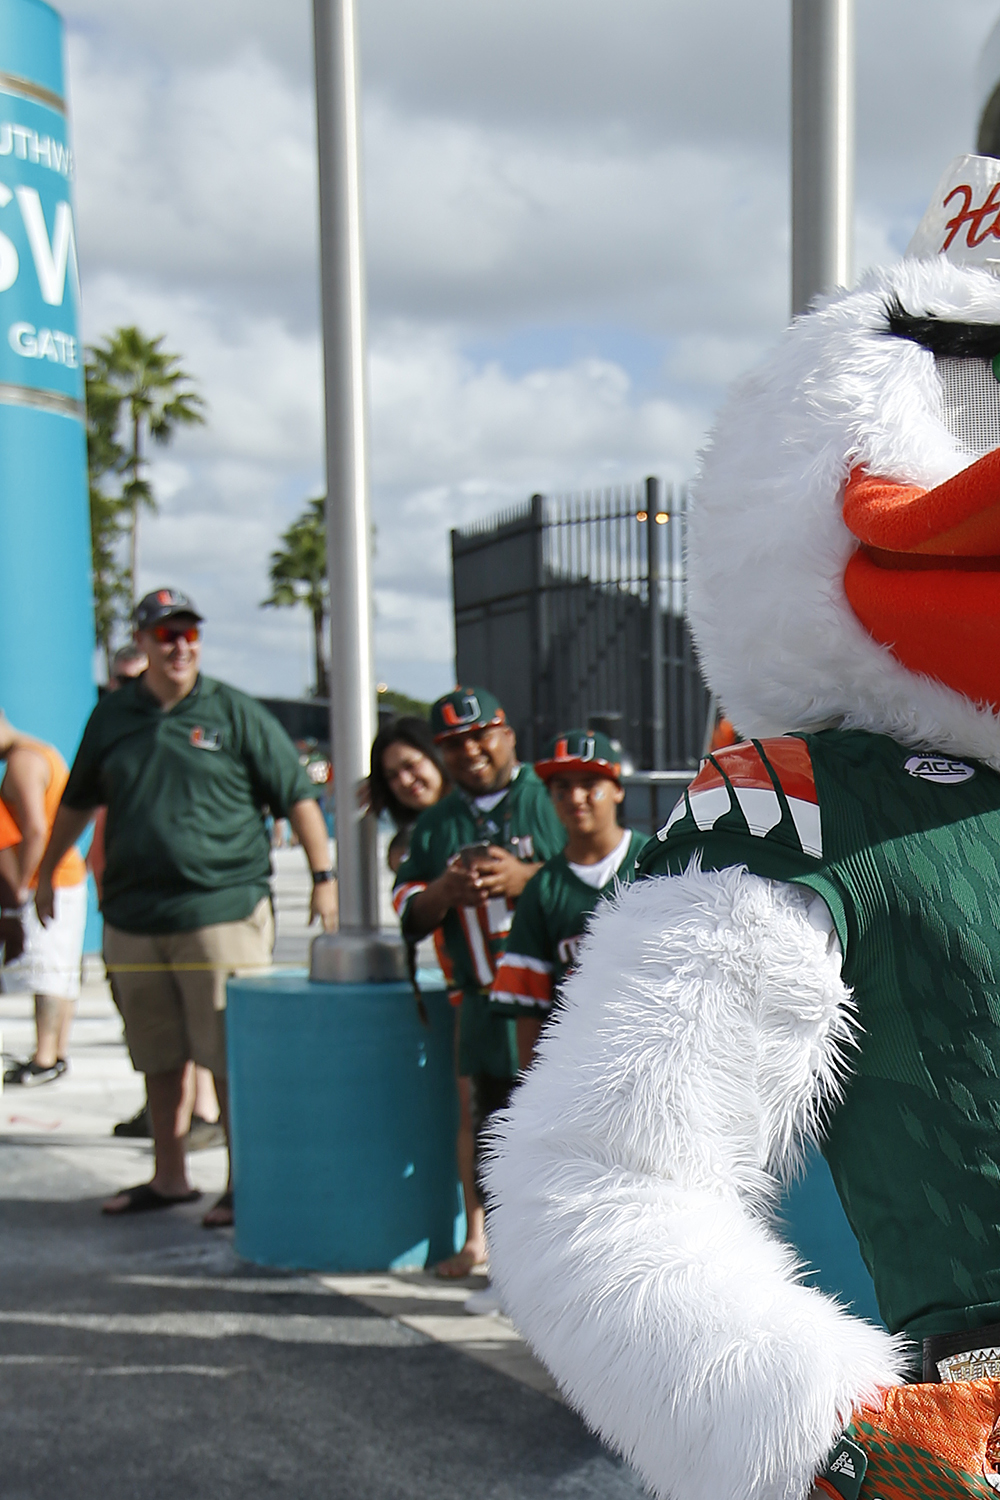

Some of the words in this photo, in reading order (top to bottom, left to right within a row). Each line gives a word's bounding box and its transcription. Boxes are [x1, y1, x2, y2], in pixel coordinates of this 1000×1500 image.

[8, 321, 78, 369] GATE
[442, 695, 482, 727] U
[190, 725, 223, 751] U
[554, 737, 596, 763] U
[914, 760, 967, 775] ACC
